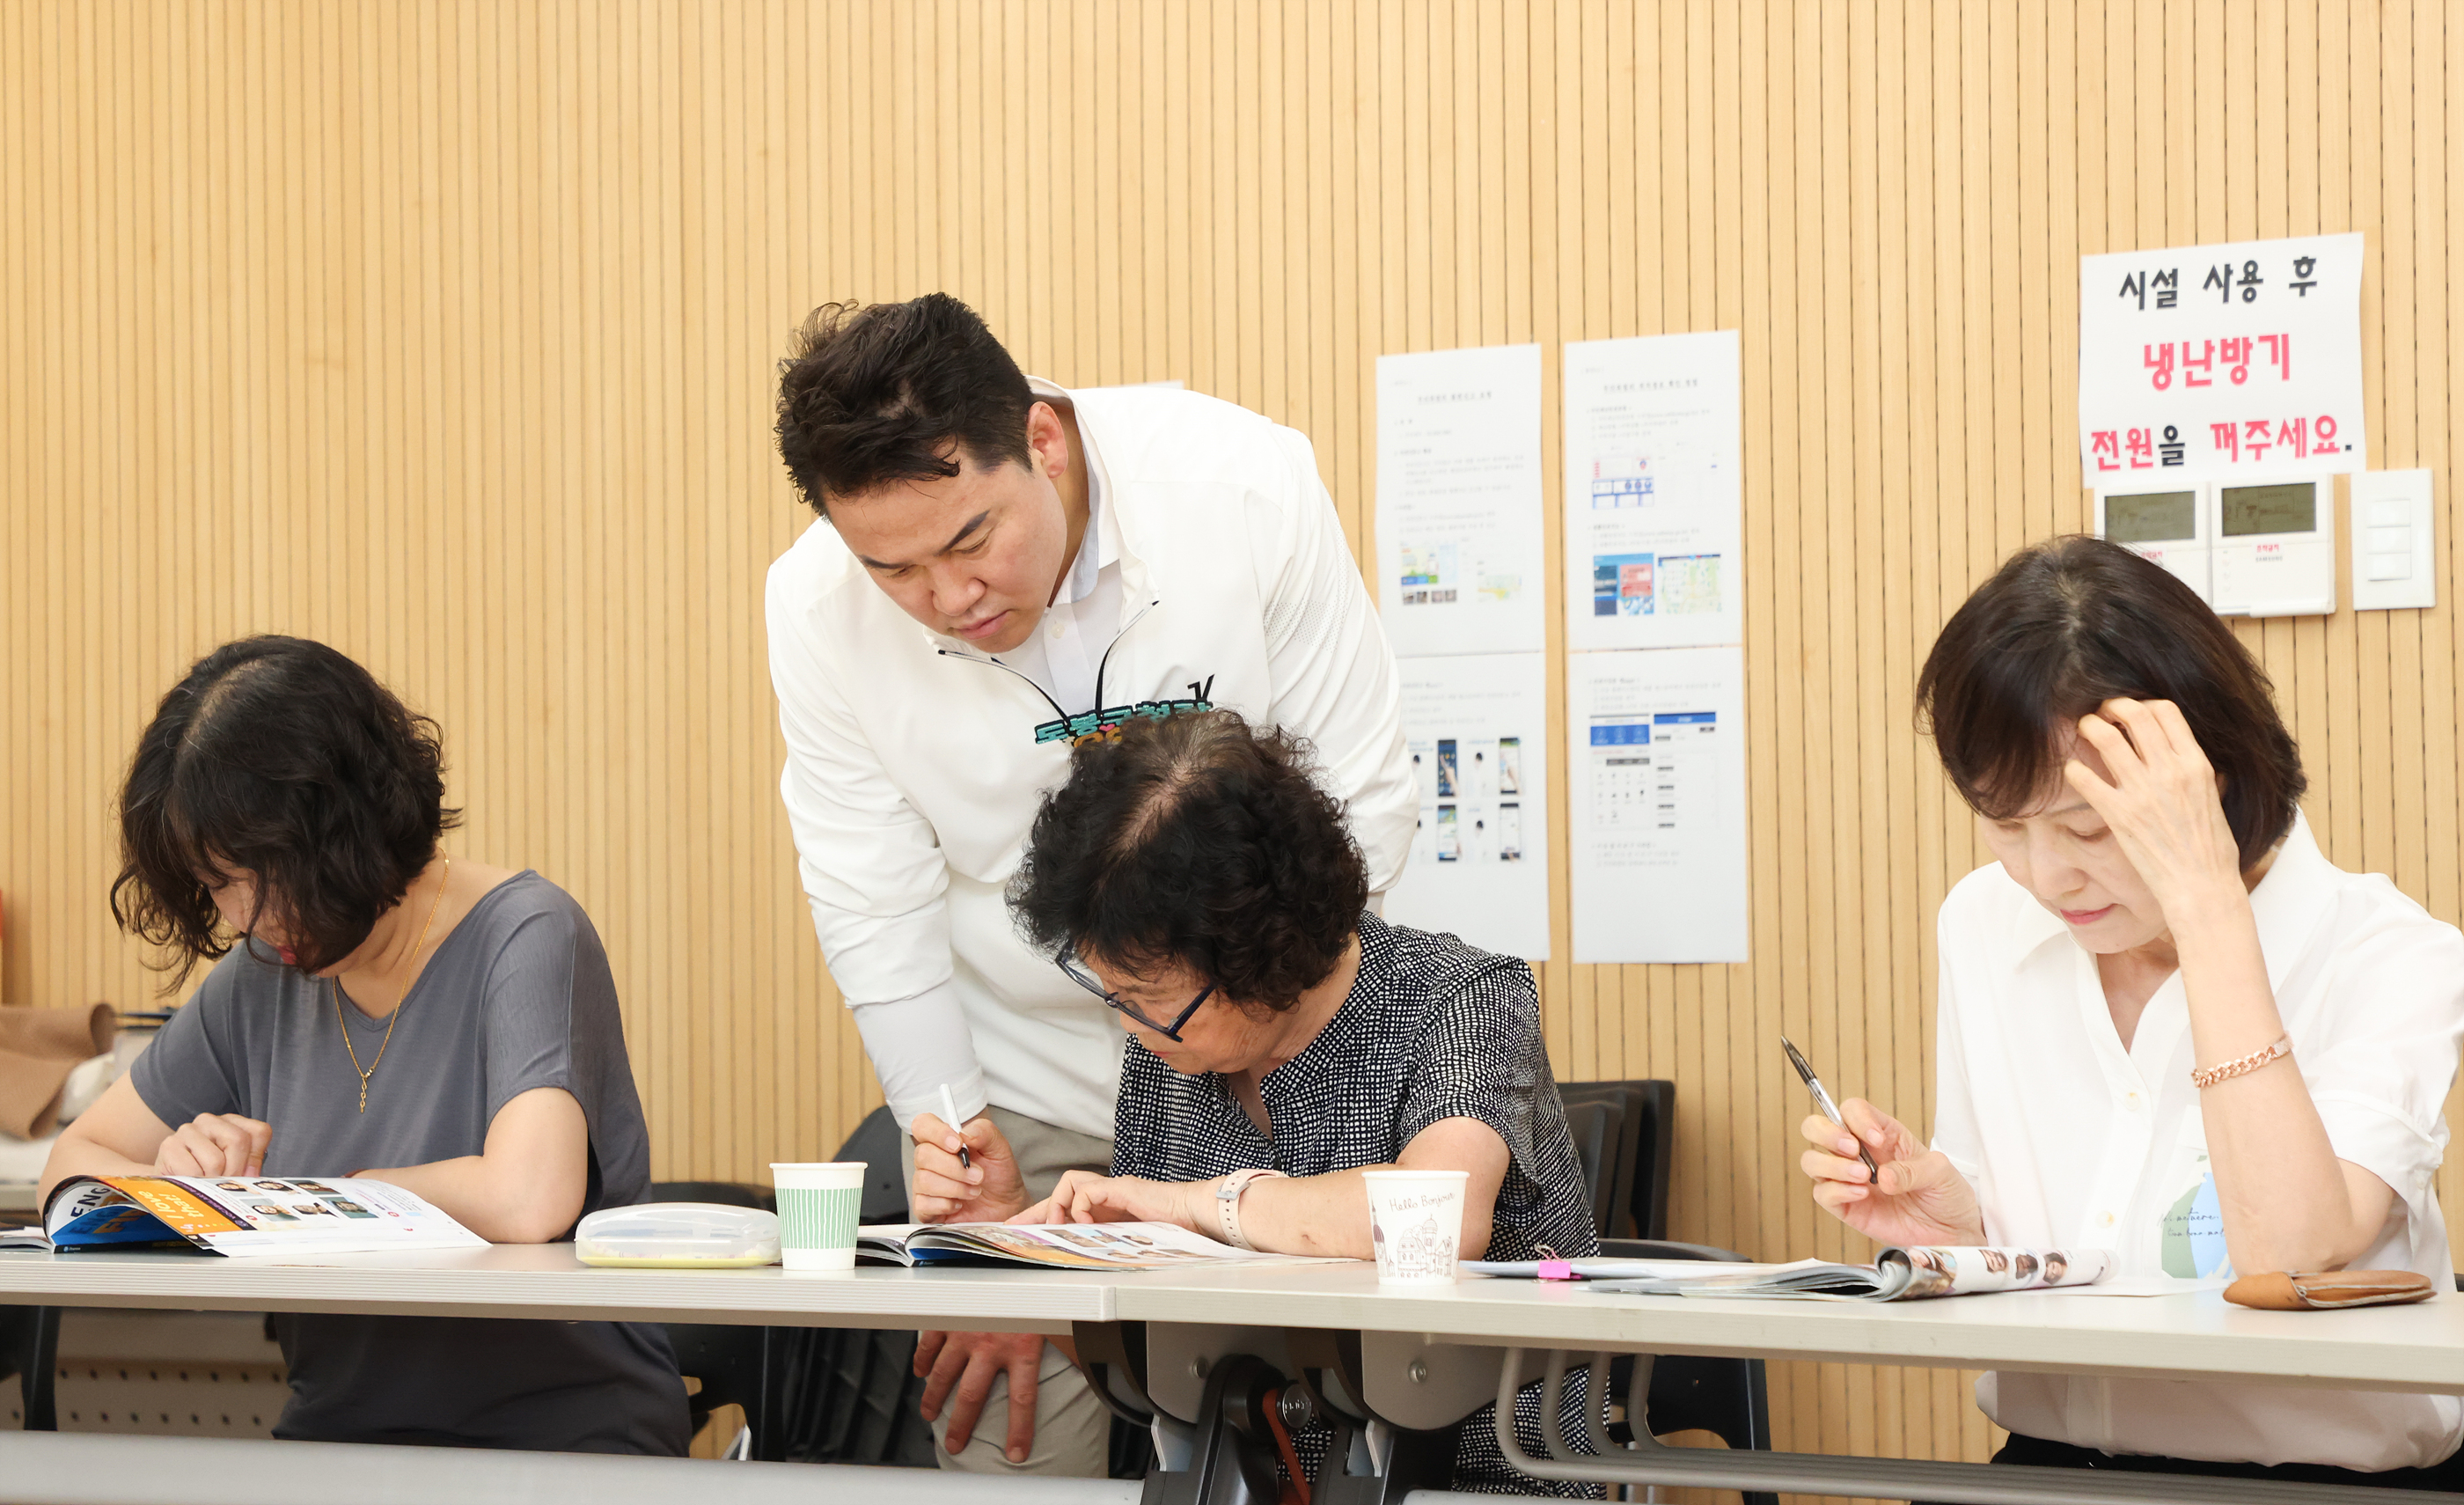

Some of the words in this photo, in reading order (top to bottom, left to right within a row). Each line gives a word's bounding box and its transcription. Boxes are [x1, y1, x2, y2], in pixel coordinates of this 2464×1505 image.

[2118, 268, 2179, 311] 시설
[2203, 261, 2264, 304] 사용
[2288, 255, 2318, 297] 후
[2144, 333, 2290, 391] 냉난방기
[2091, 424, 2186, 472] 전원을
[2210, 415, 2353, 463] 꺼주세요.
[138, 1191, 176, 1213] love
[158, 1193, 205, 1218] that!
[1389, 1198, 1419, 1213] Hello
[1420, 1193, 1456, 1208] Bonjour
